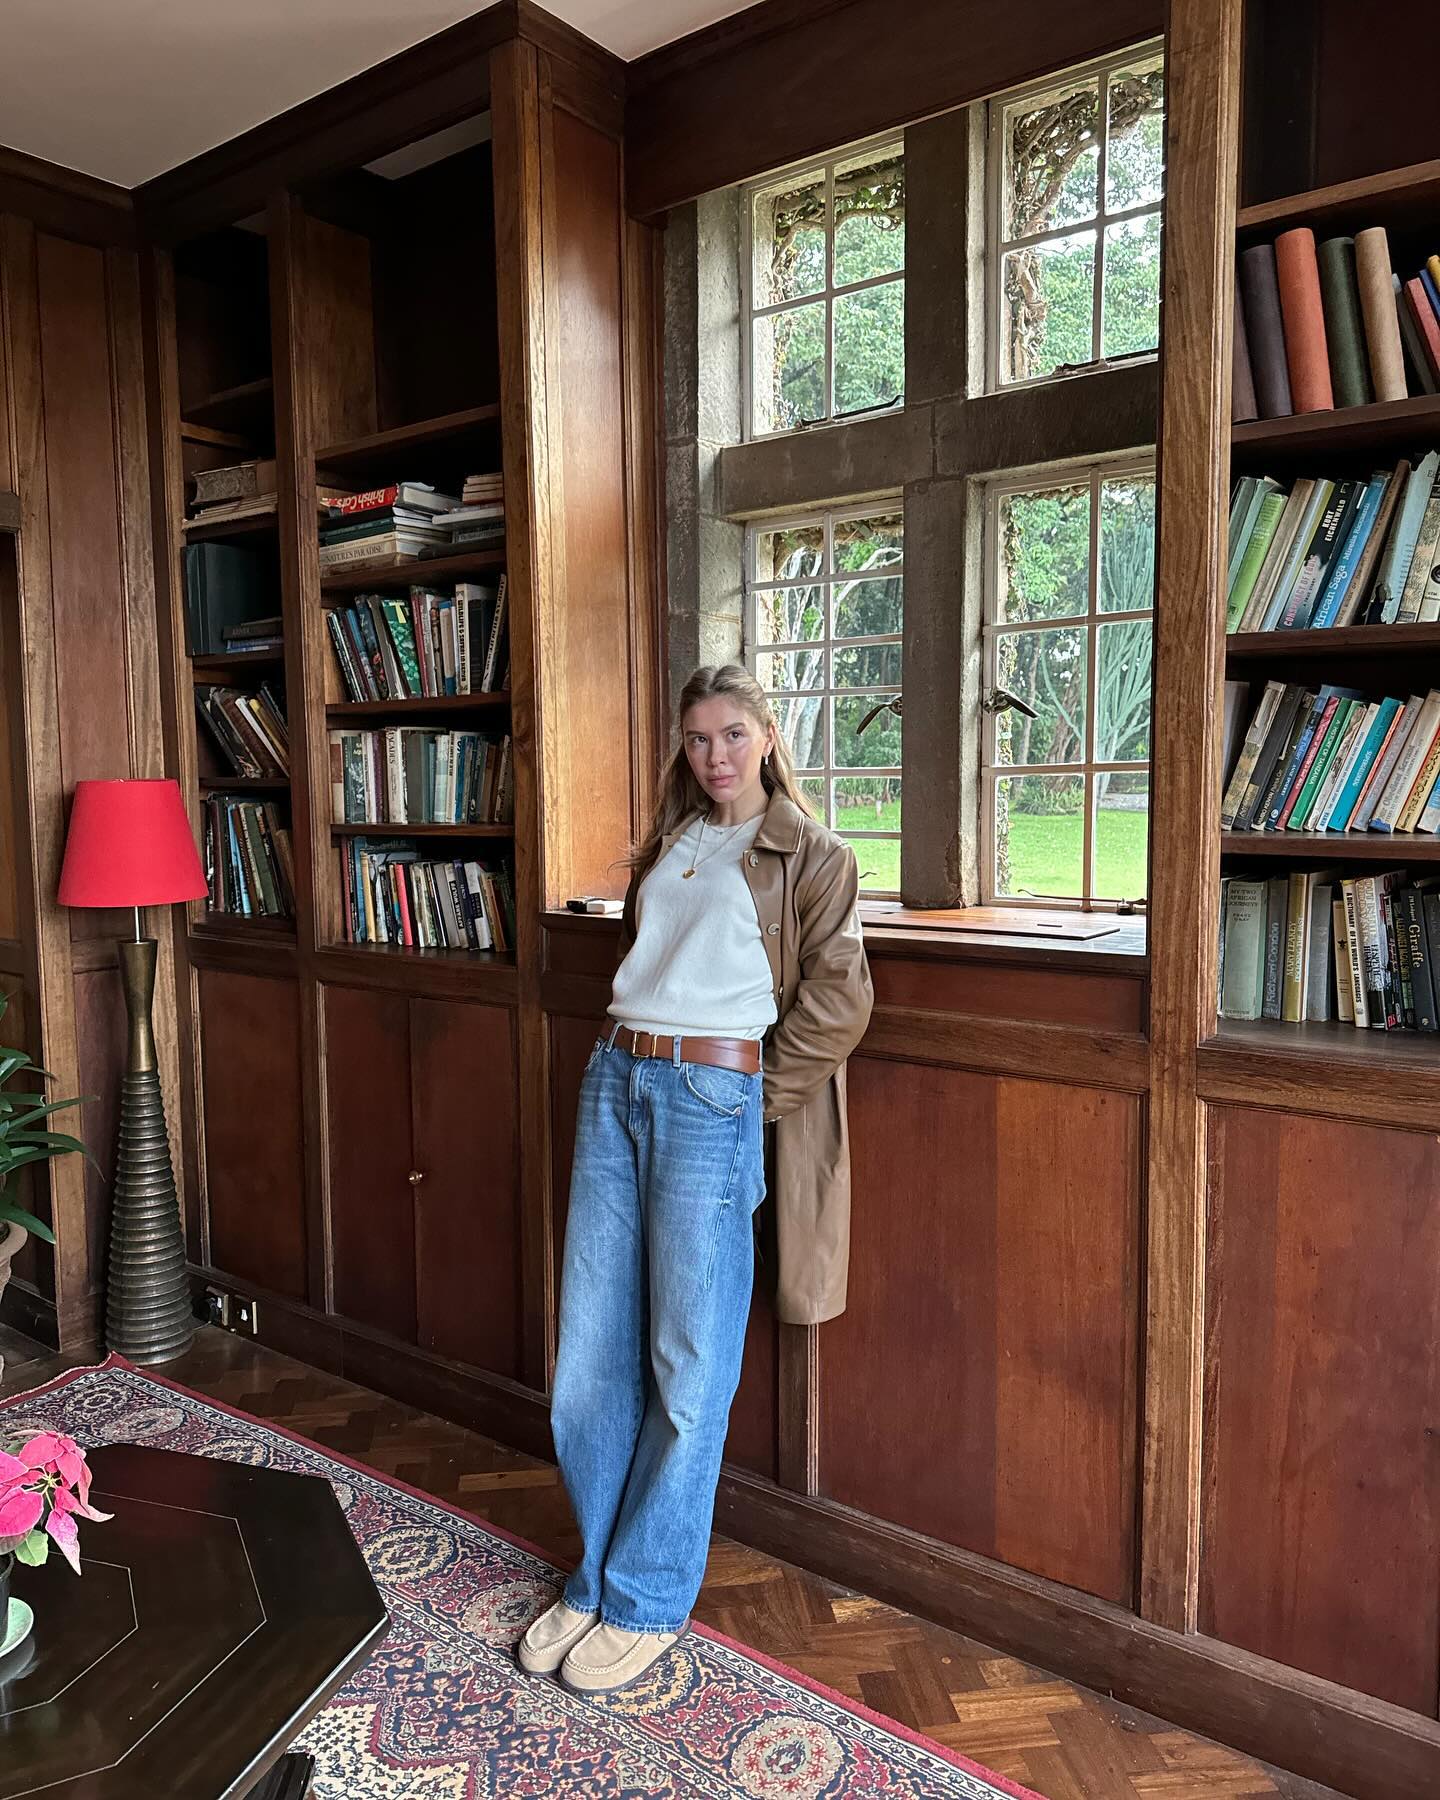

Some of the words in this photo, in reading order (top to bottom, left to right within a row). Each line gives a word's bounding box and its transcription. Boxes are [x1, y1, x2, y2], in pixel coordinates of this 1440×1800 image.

[357, 489, 386, 507] British
[1321, 509, 1334, 528] KURT
[1324, 499, 1346, 541] EICHENWALD
[1299, 575, 1309, 585] OF
[1312, 588, 1334, 629] African
[1328, 564, 1348, 592] Saga
[1324, 725, 1337, 748] HISTORY
[1321, 748, 1328, 756] OF
[1308, 756, 1324, 785] TANZANIA
[1407, 797, 1418, 812] THE
[1346, 897, 1355, 927] DICTIONARY
[1288, 921, 1296, 952] LEAKEY
[1394, 917, 1407, 947] ALEXANDER
[1408, 923, 1424, 967] Giraffe
[1287, 952, 1295, 976] MARY
[1350, 947, 1359, 970] WORLD'S
[1370, 944, 1381, 975] ELSPETH
[1266, 961, 1277, 1002] Richard
[1353, 973, 1362, 1003] LANGUAGES
